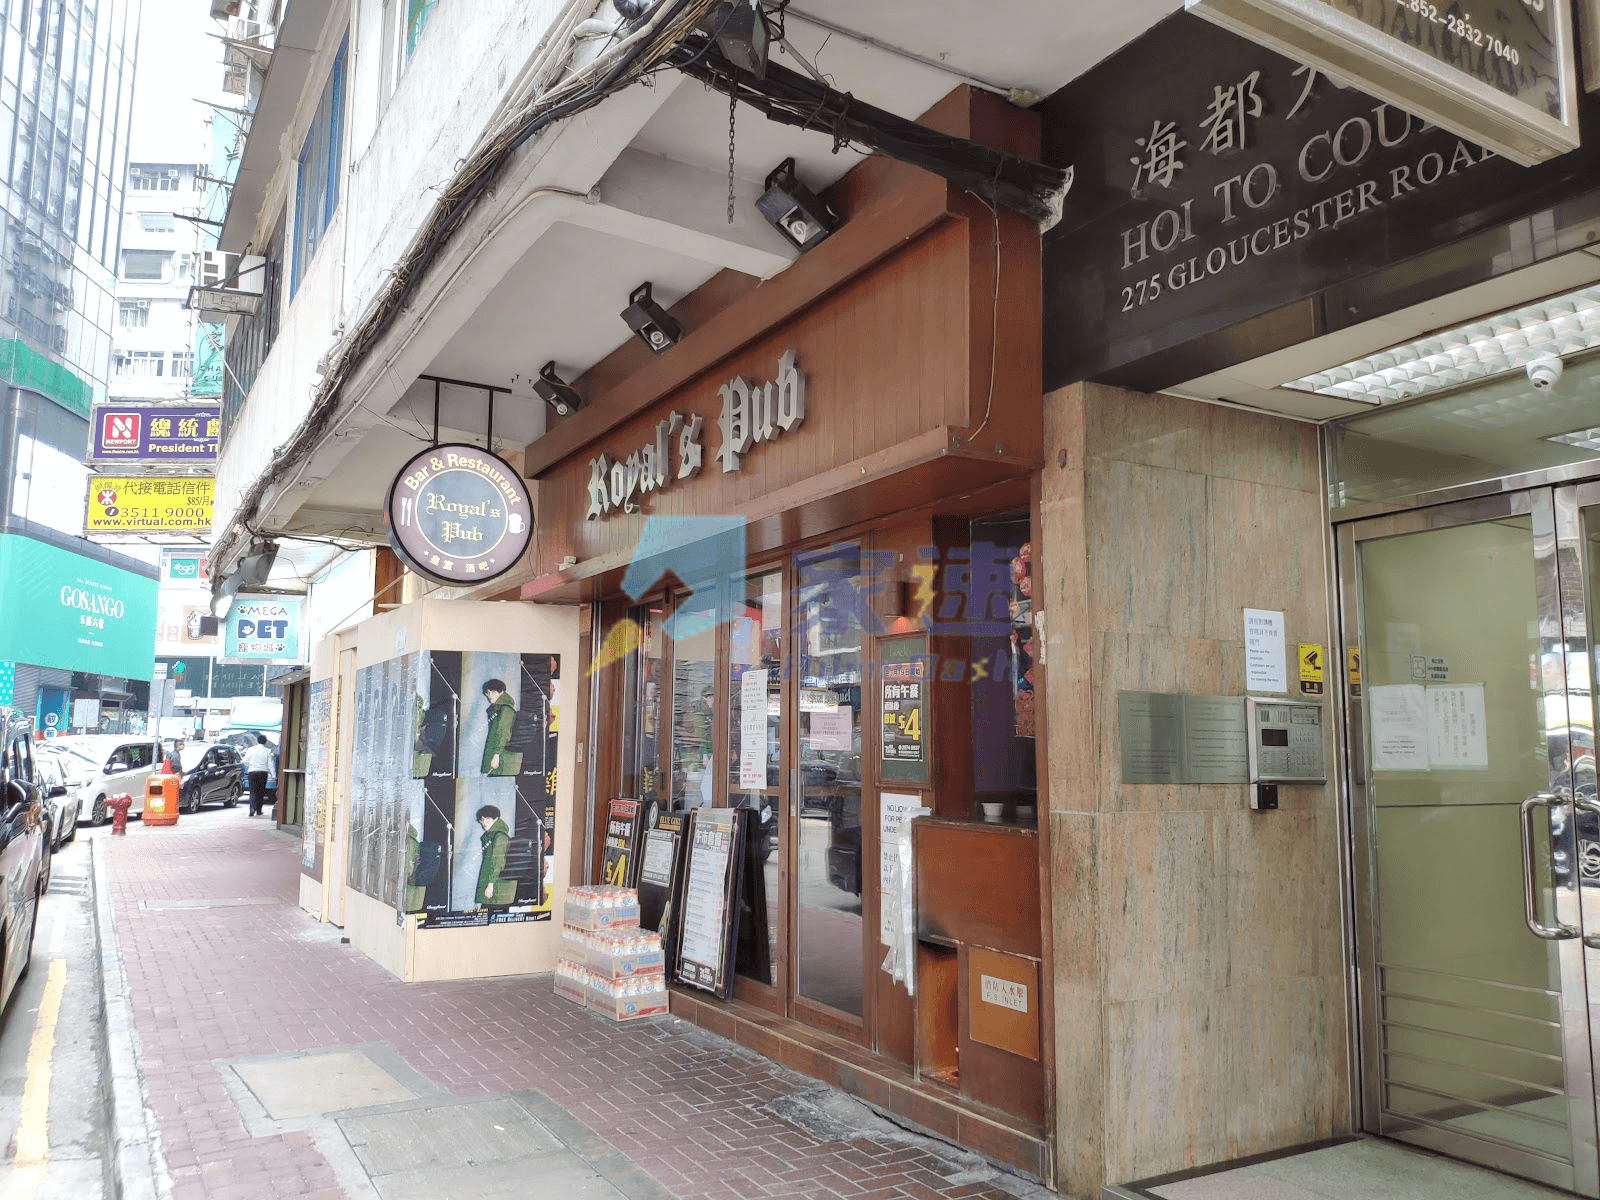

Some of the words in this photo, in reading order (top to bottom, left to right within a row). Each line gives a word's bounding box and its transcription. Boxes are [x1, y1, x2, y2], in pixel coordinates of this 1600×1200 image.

[1485, 35, 1519, 65] 7040
[1120, 199, 1197, 269] HOI
[1213, 163, 1277, 223] TO
[1121, 273, 1161, 312] 275
[1168, 180, 1383, 291] GLOUCESTER
[586, 409, 703, 521] Royal's
[715, 349, 806, 474] Pub
[148, 443, 205, 453] President
[123, 481, 211, 496] 代接電話信件
[404, 465, 429, 491] Bar
[430, 457, 445, 471] &
[447, 453, 522, 505] Restaurant
[120, 507, 159, 518] 3511
[164, 507, 205, 518] 9000
[426, 492, 502, 520] Royal's
[93, 517, 212, 526] www.virtual.com.hk
[441, 520, 484, 544] Pub
[60, 585, 125, 619] GOSANGO
[238, 619, 288, 639] PET
[884, 683, 919, 699] 所有午餐
[898, 709, 921, 741] $4
[884, 815, 895, 823] FOR
[886, 804, 895, 812] NO
